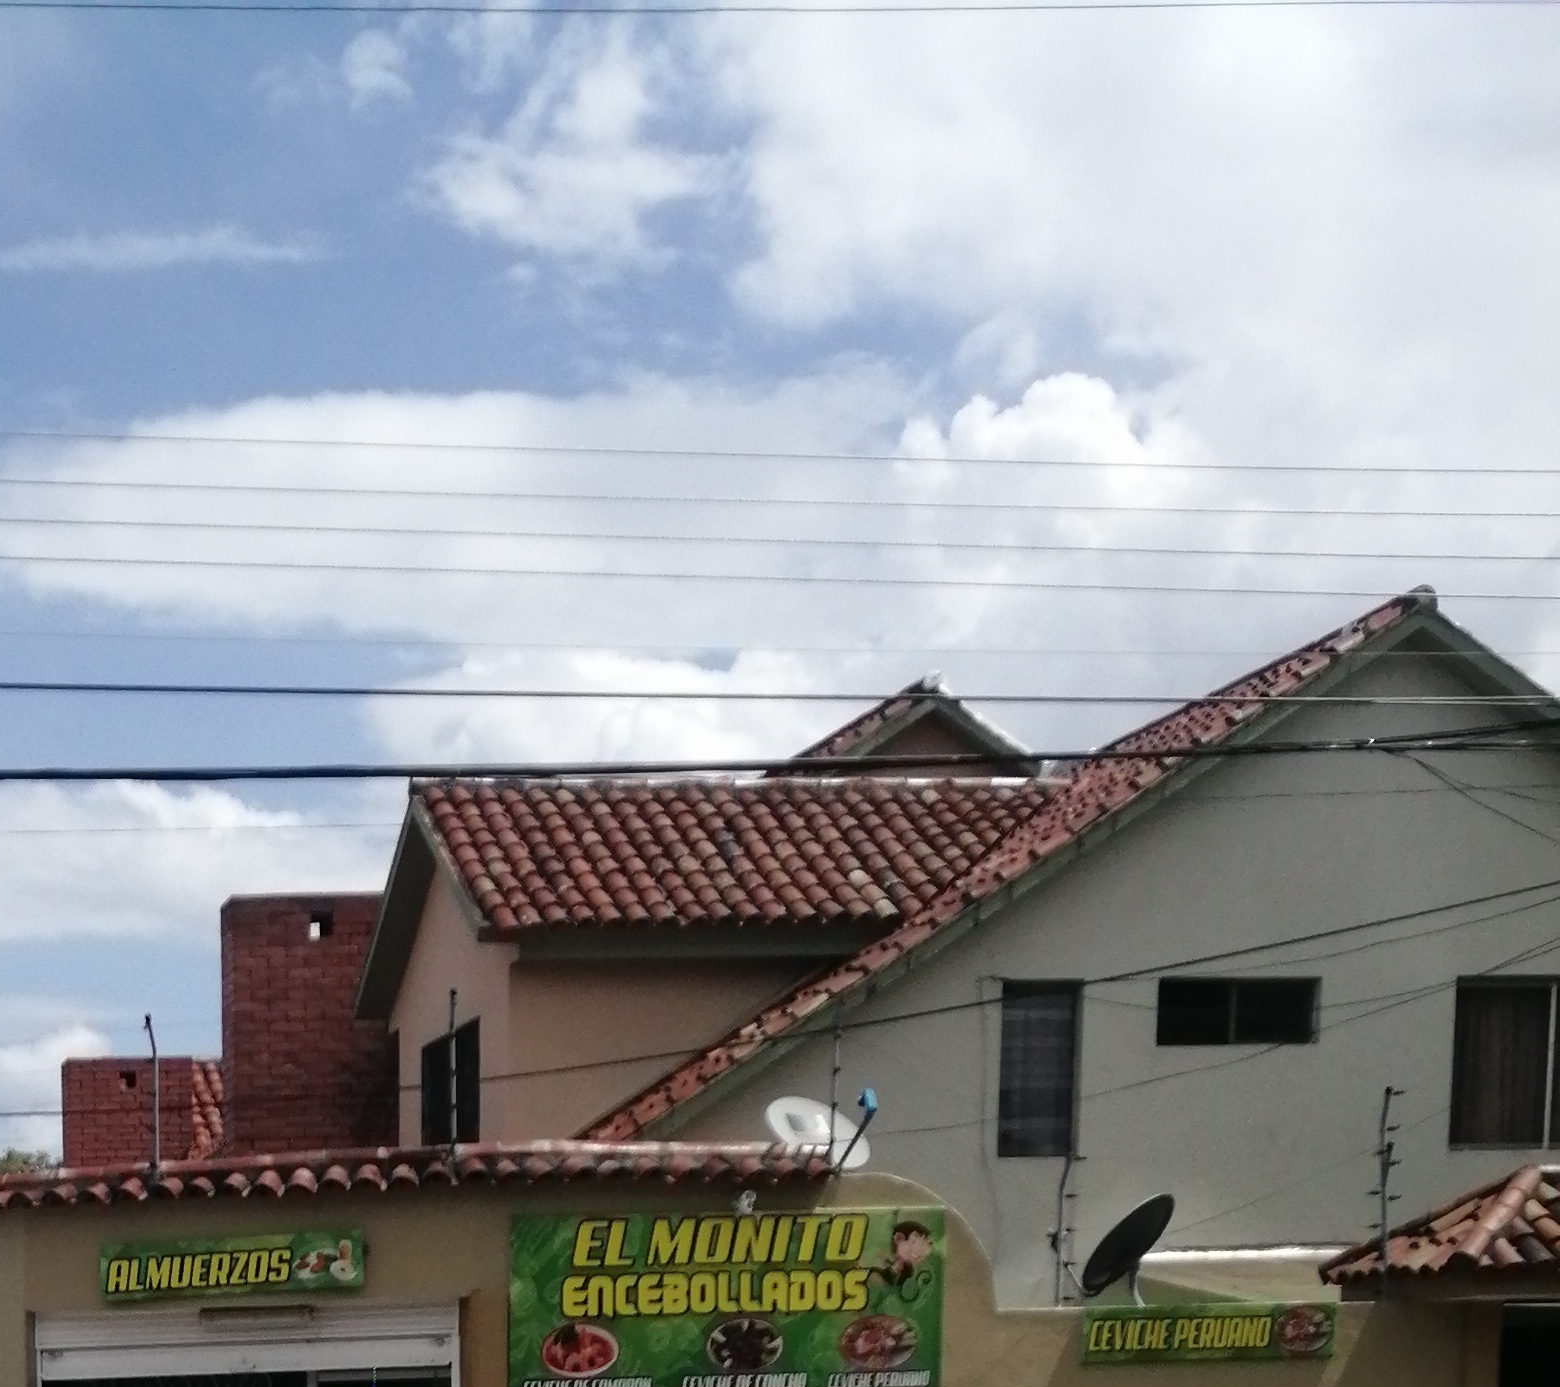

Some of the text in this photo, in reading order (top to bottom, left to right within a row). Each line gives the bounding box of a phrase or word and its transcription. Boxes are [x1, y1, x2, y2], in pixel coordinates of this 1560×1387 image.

[573, 1213, 869, 1268] EL MONITO
[107, 1248, 291, 1293] ALMUERZOS
[561, 1268, 871, 1318] ENCEBOLLADOS
[1090, 1315, 1272, 1351] CEVICHE PERUANO
